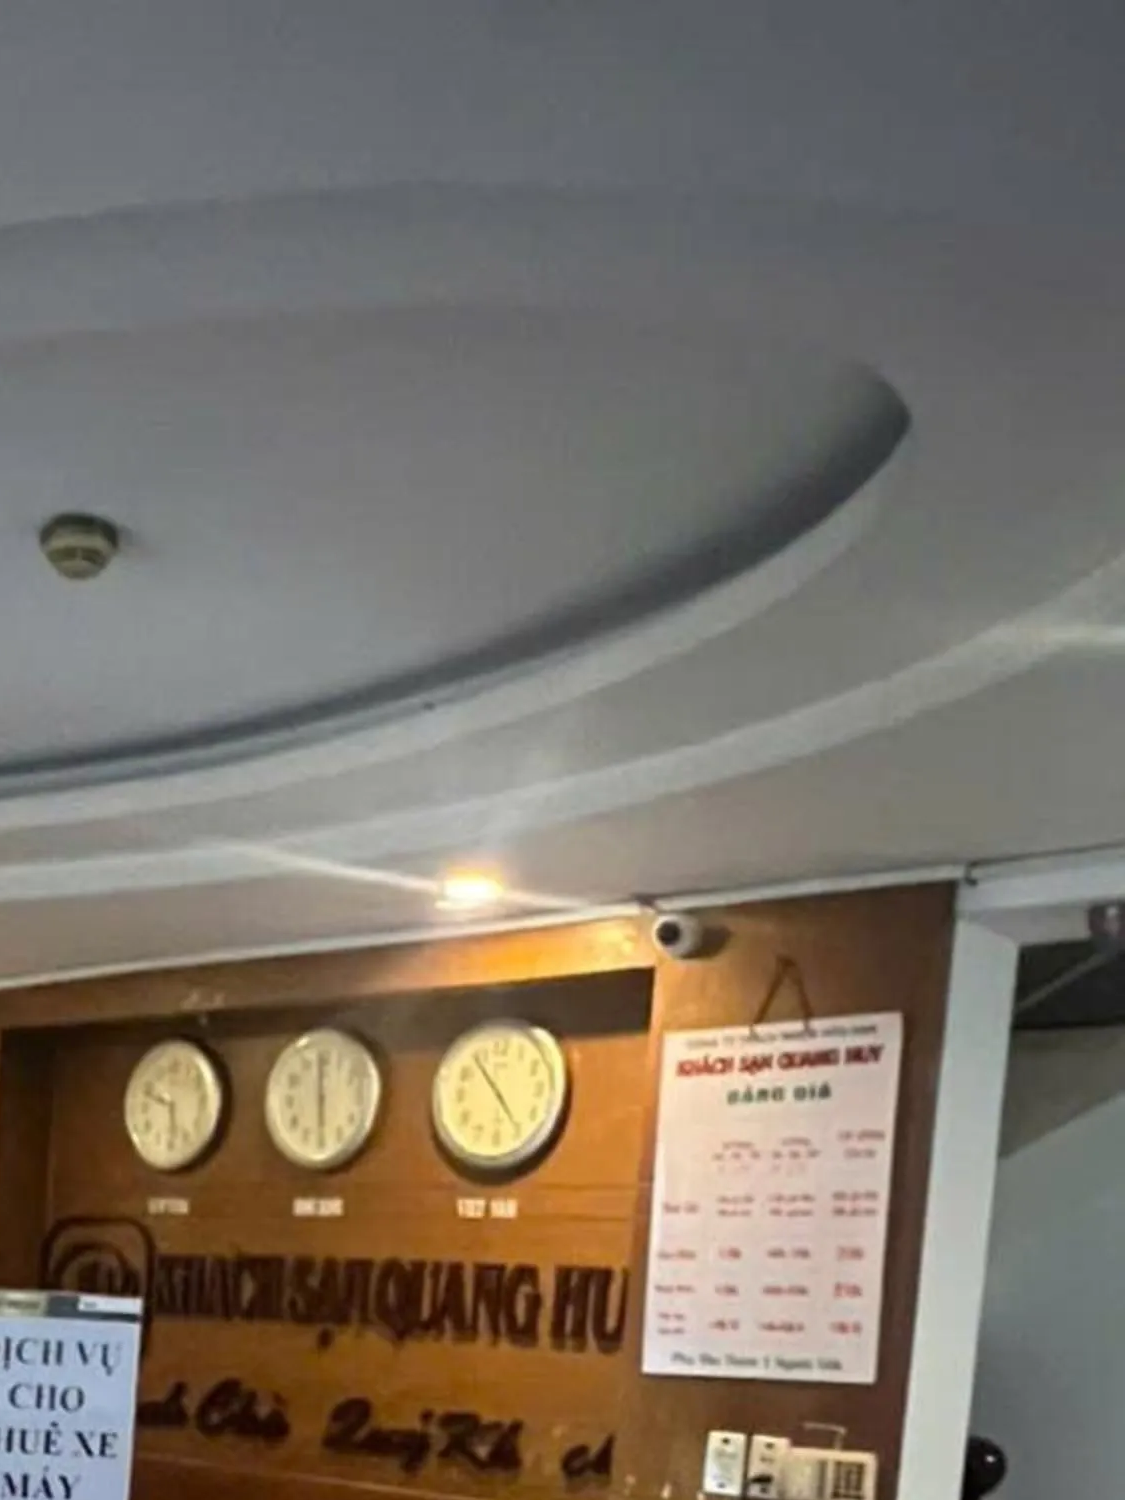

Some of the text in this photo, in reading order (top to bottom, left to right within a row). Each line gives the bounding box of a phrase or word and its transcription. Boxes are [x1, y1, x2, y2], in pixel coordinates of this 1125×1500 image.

[550, 1262, 630, 1354] HU
[76, 1338, 124, 1377] VỤ
[7, 1382, 86, 1413] CHO
[71, 1431, 119, 1459] XE
[1, 1466, 82, 1500] MÁY
